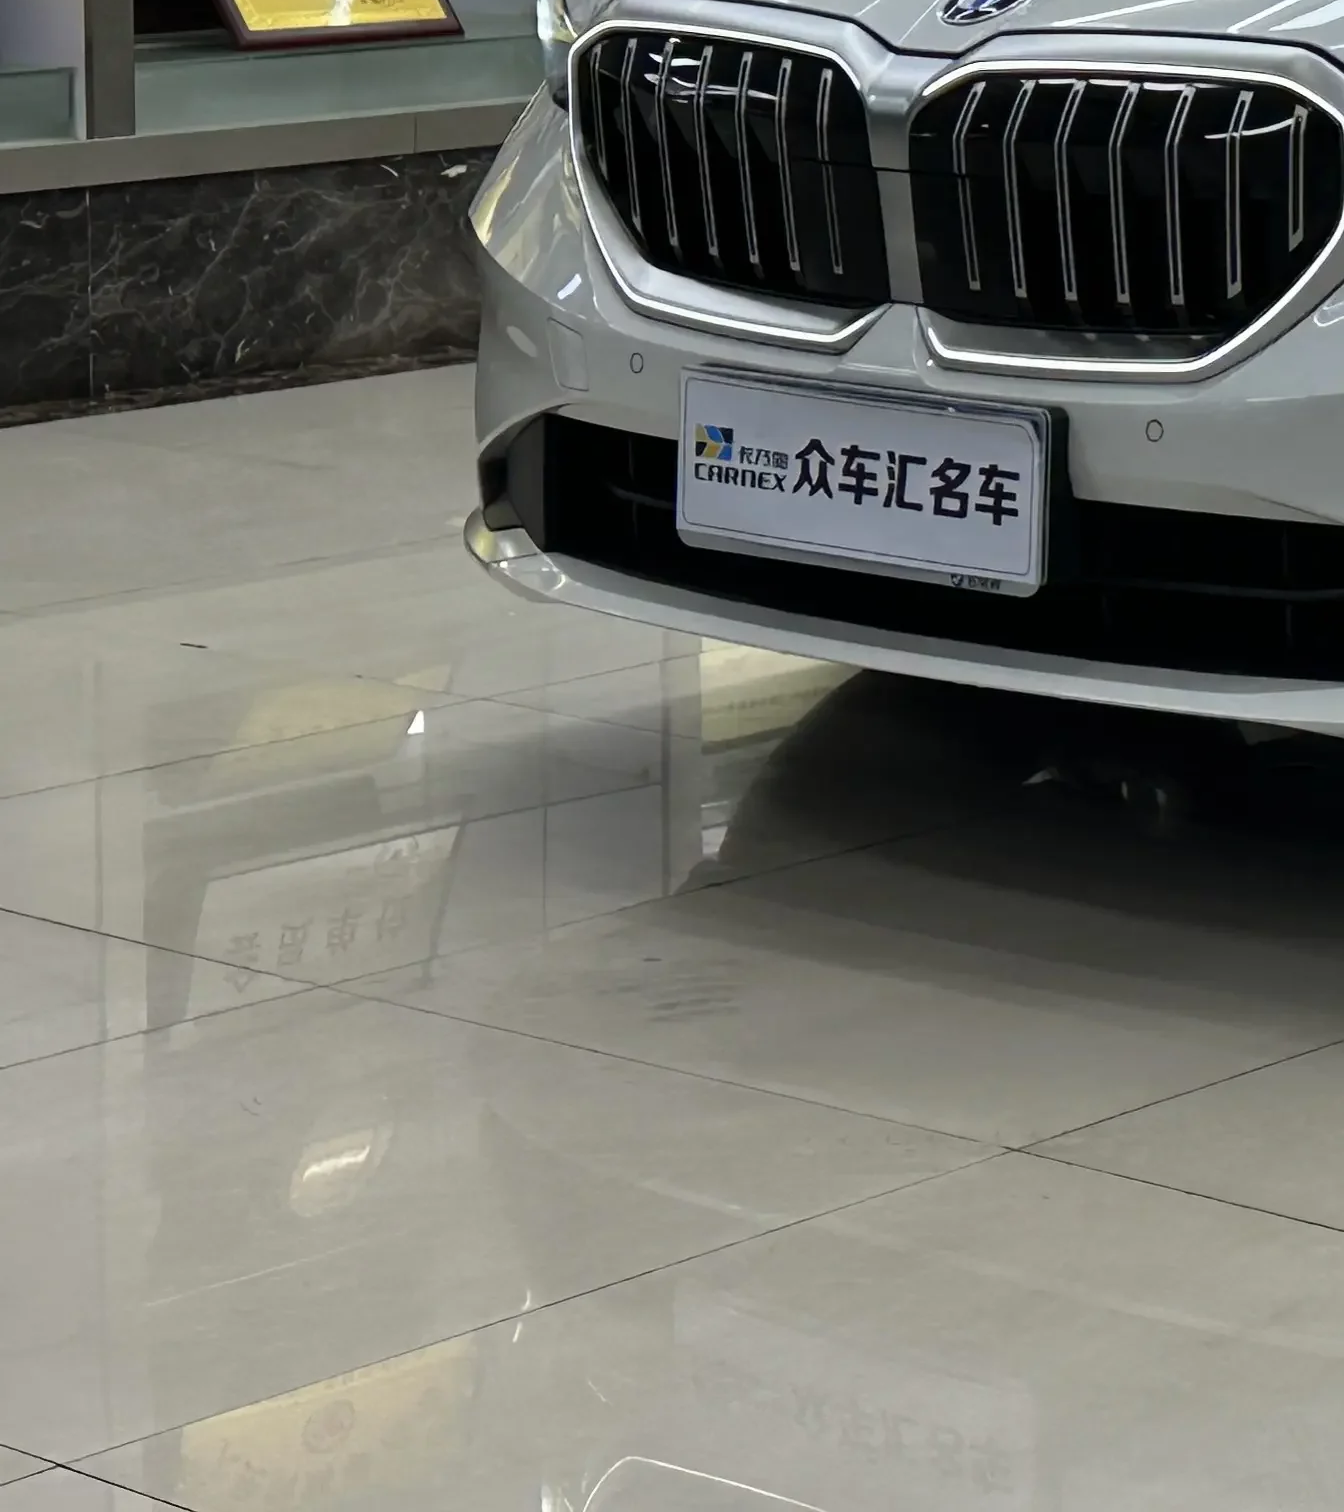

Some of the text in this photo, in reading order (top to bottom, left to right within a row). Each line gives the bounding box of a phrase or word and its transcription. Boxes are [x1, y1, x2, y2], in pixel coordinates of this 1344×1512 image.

[694, 462, 788, 493] CARNEX
[791, 438, 1021, 526] 众车汇名车
